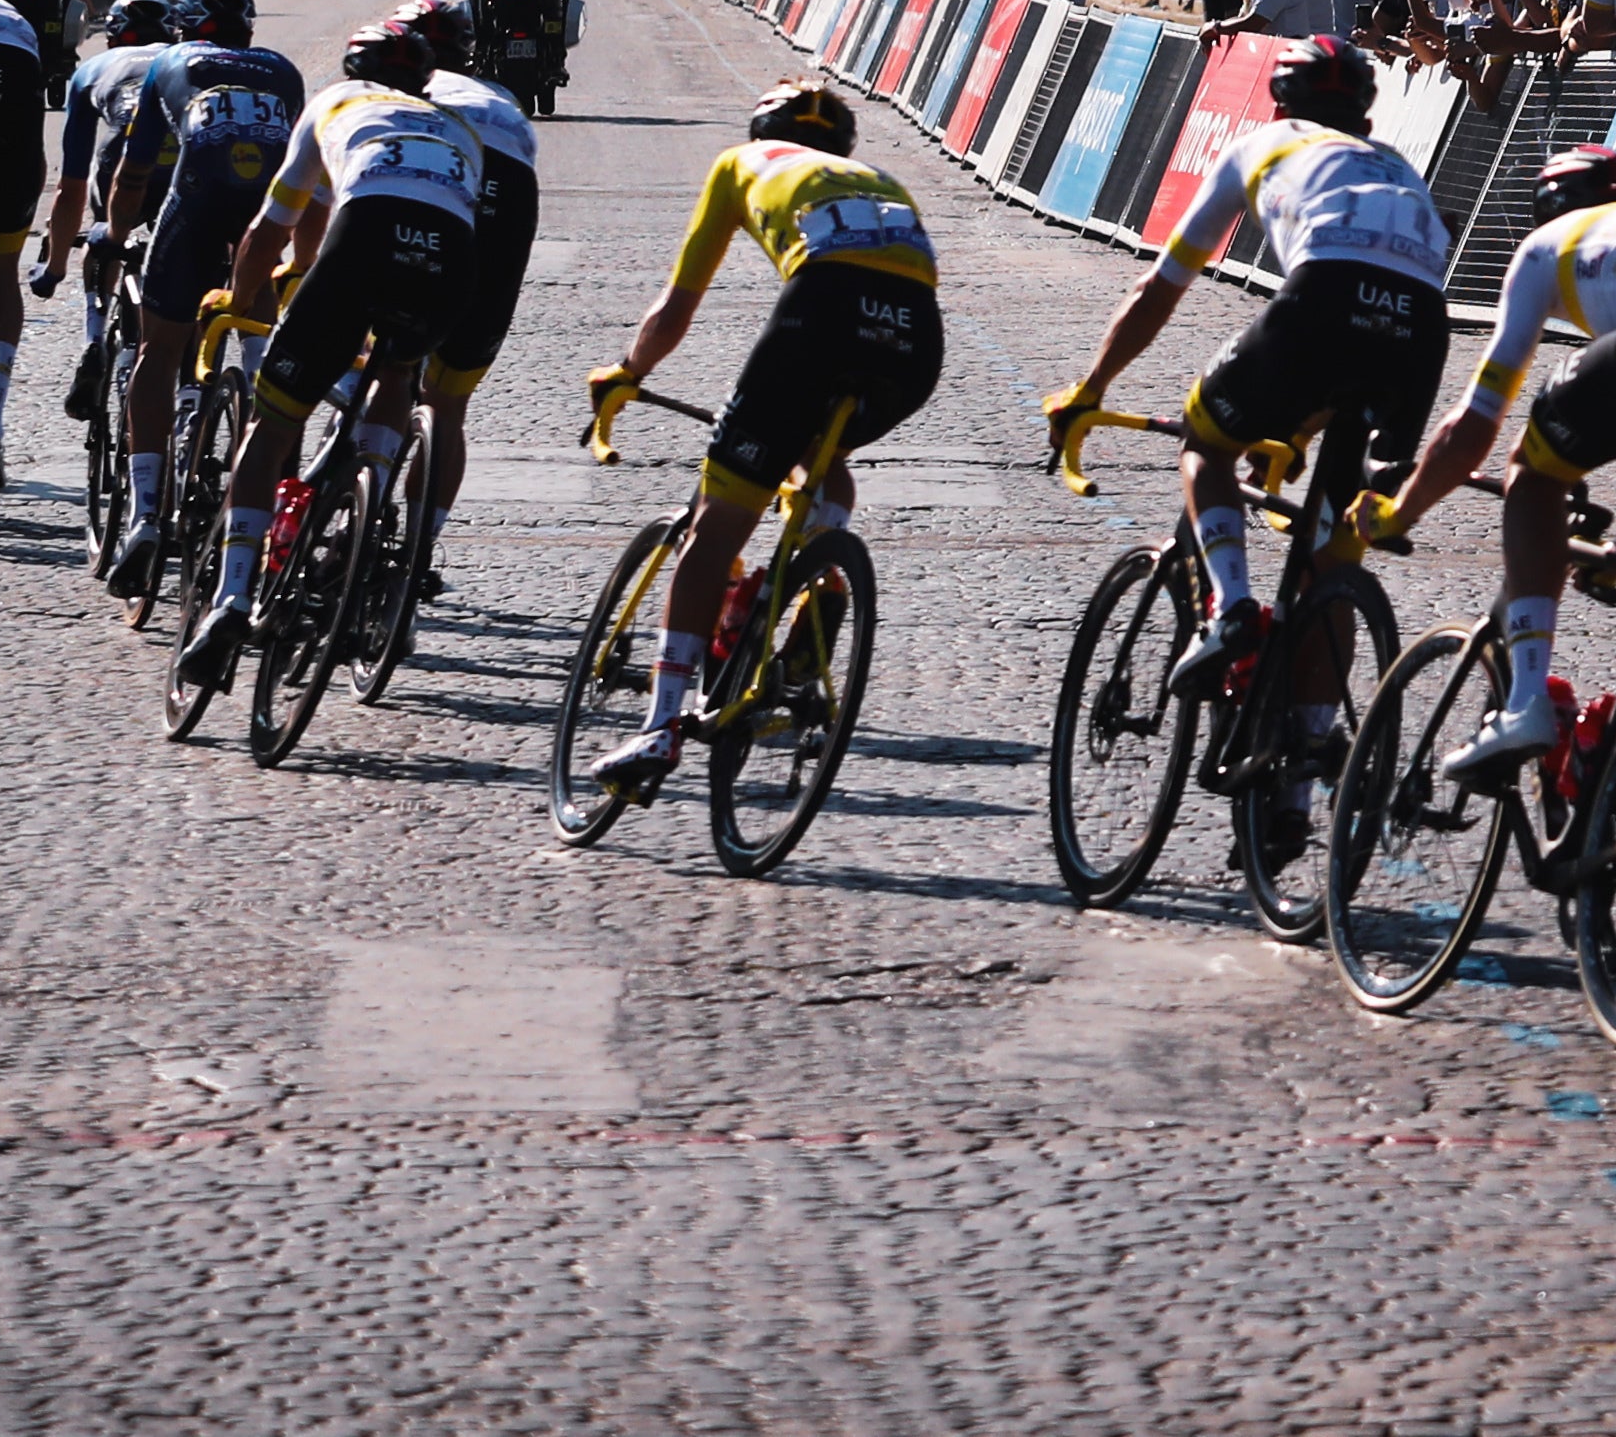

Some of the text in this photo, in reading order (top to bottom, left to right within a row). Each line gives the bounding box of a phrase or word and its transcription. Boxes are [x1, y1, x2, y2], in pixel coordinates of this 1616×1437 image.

[200, 92, 285, 128] 54 54
[382, 141, 465, 181] 3 3
[826, 203, 844, 230] 1
[394, 223, 441, 251] UAE
[859, 295, 913, 329] UAE
[1356, 280, 1413, 316] UAE
